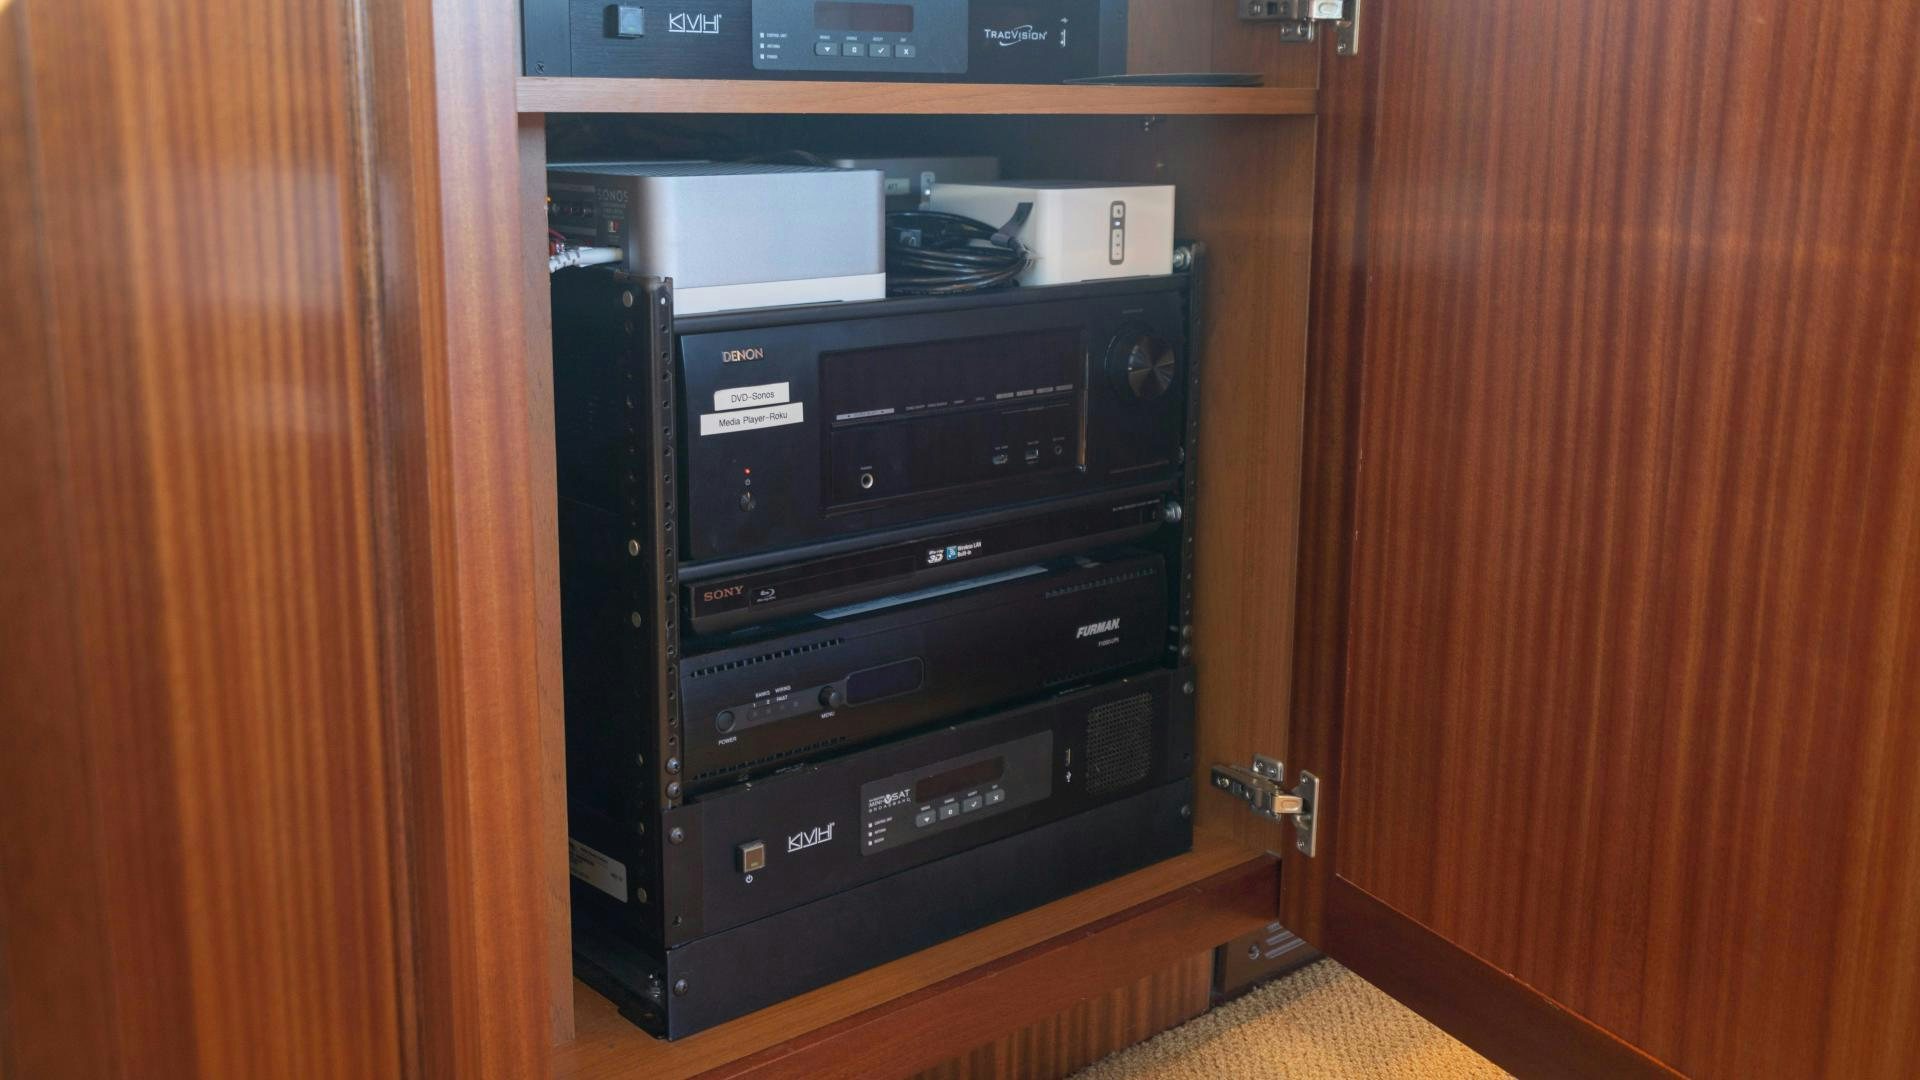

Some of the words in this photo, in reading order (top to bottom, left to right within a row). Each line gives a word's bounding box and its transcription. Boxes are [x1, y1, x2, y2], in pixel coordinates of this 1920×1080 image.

[669, 13, 722, 34] KVH
[597, 188, 629, 203] SONOS
[722, 347, 764, 363] DENON
[730, 391, 775, 404] DVD-Sonos
[718, 416, 741, 428] Media
[742, 411, 788, 427] Player-Roku
[704, 585, 744, 603] SONY
[1076, 618, 1121, 639] FURMAN
[718, 736, 737, 746] POWER
[787, 821, 835, 854] KVH
